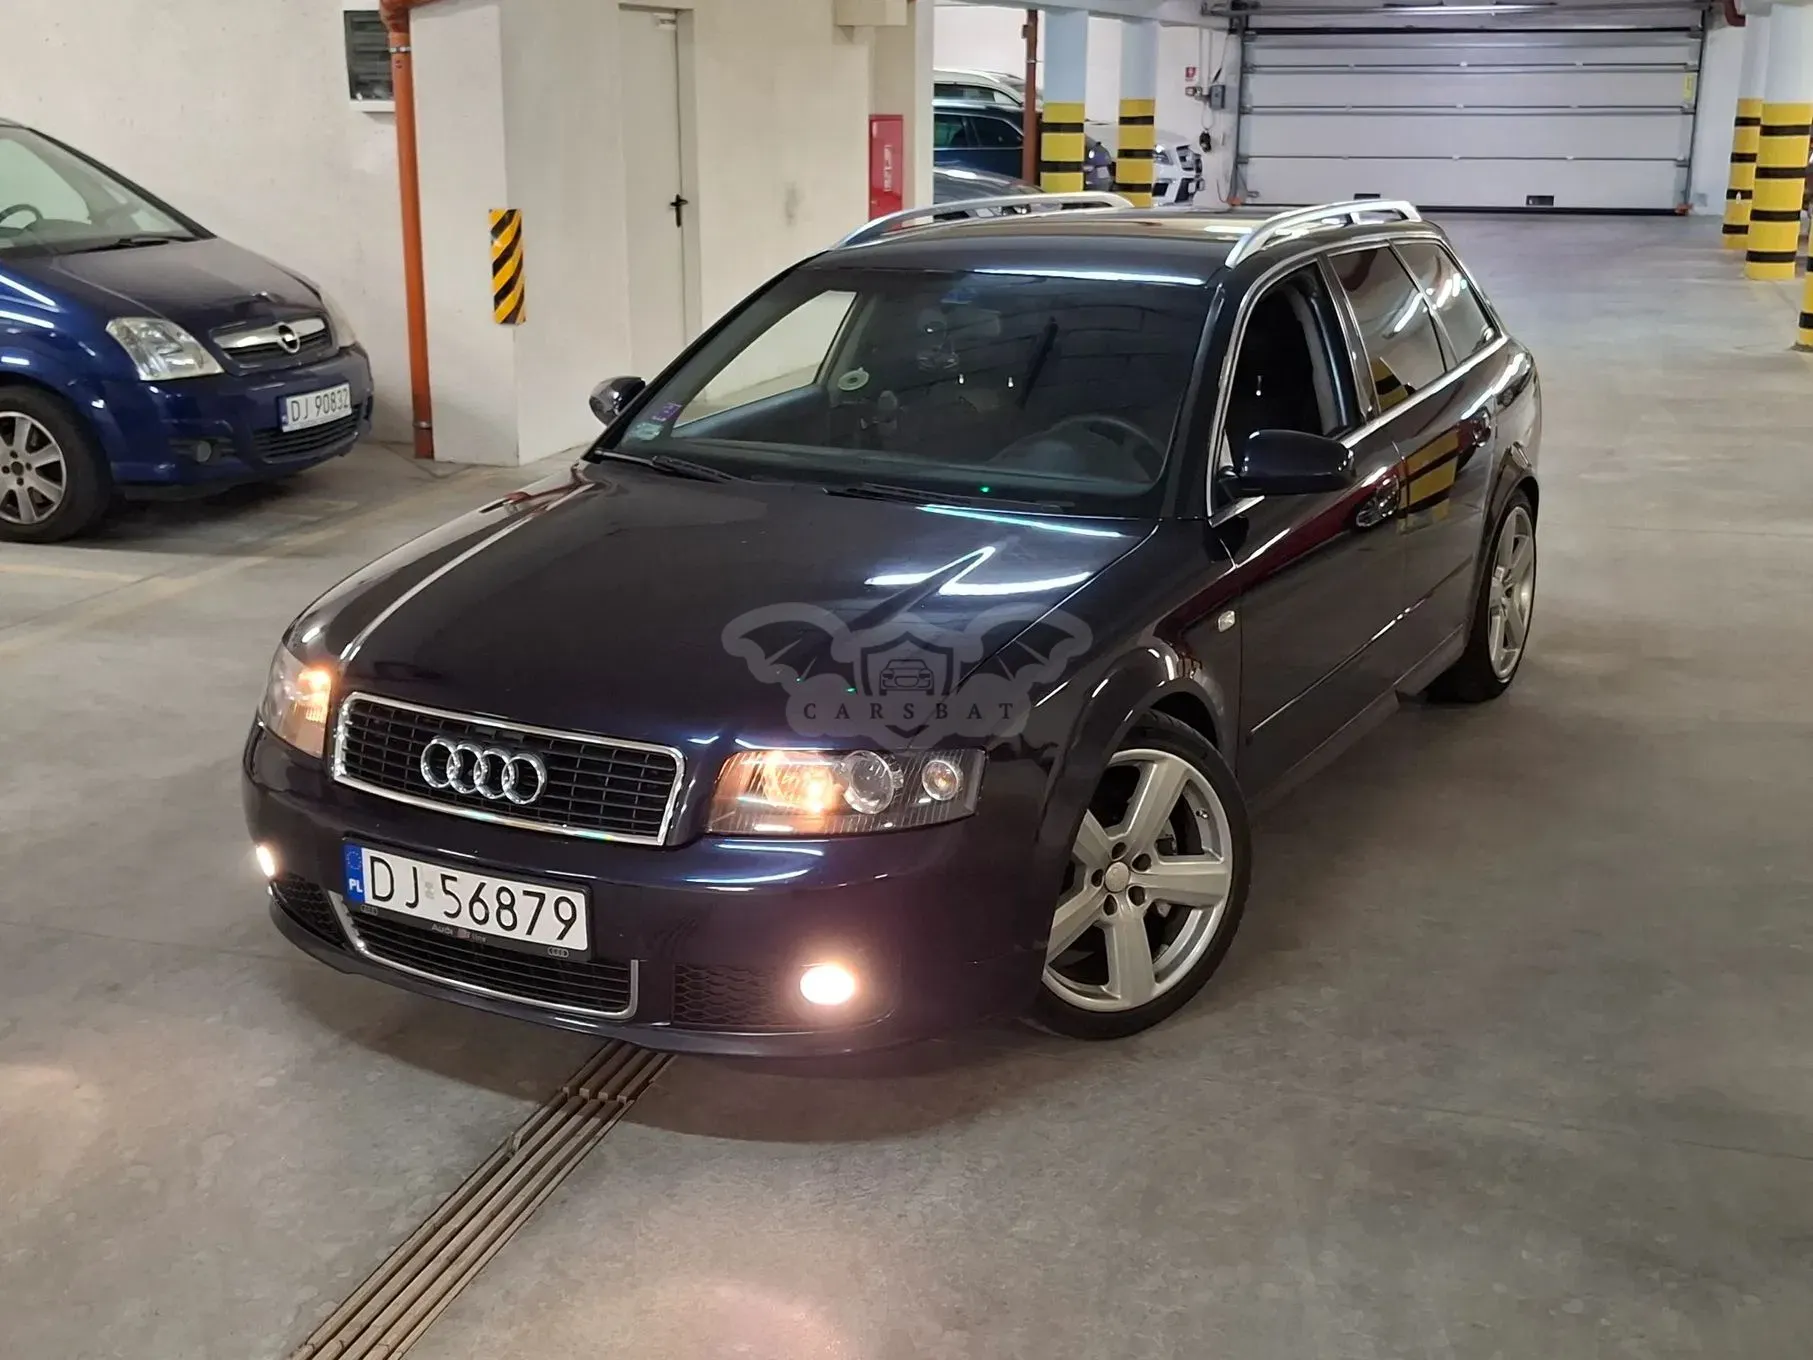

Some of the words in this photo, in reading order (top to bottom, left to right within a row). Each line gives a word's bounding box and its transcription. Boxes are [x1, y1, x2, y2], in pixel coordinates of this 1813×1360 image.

[291, 399, 308, 421] DJ
[348, 878, 363, 893] PL
[370, 855, 420, 910] DJ
[440, 873, 577, 941] 56879
